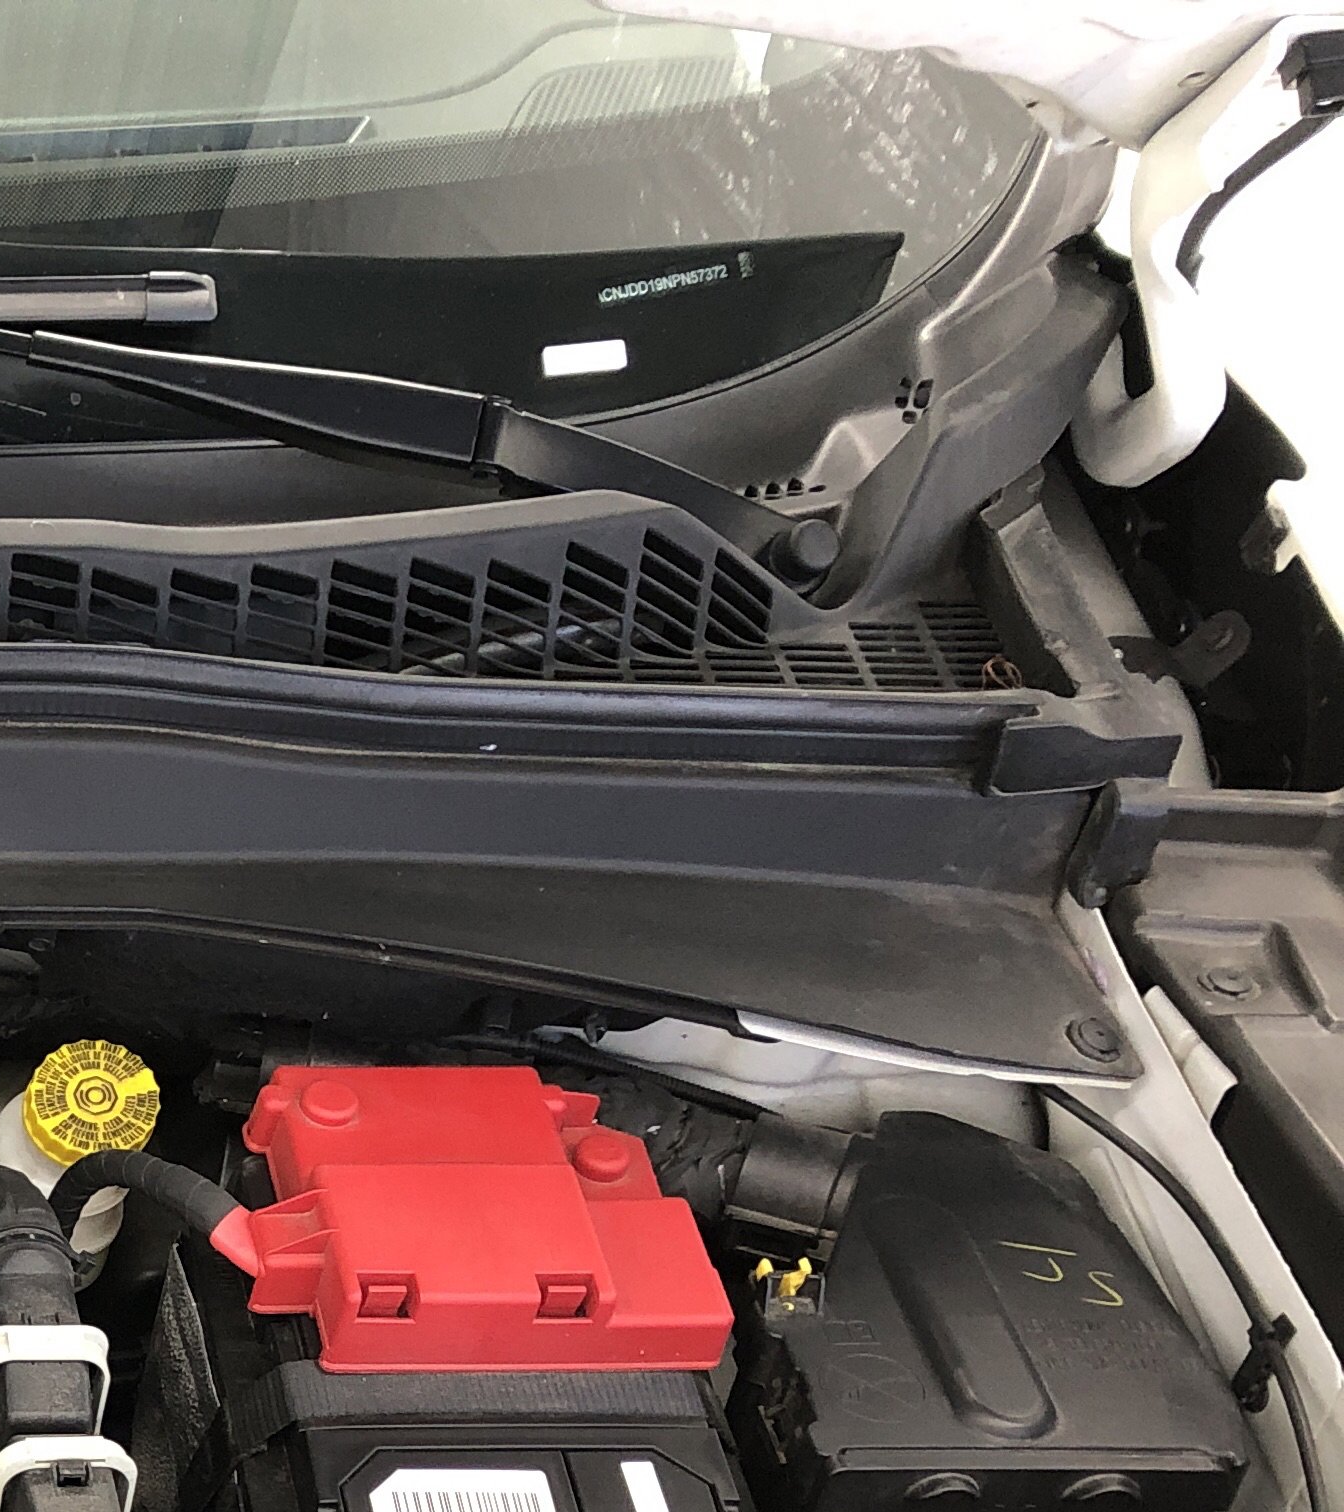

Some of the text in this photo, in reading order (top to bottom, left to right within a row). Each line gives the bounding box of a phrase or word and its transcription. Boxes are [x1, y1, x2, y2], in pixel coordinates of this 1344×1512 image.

[60, 1119, 71, 1132] CAP
[72, 1128, 99, 1141] BEFORE
[121, 1126, 146, 1146] SEALED
